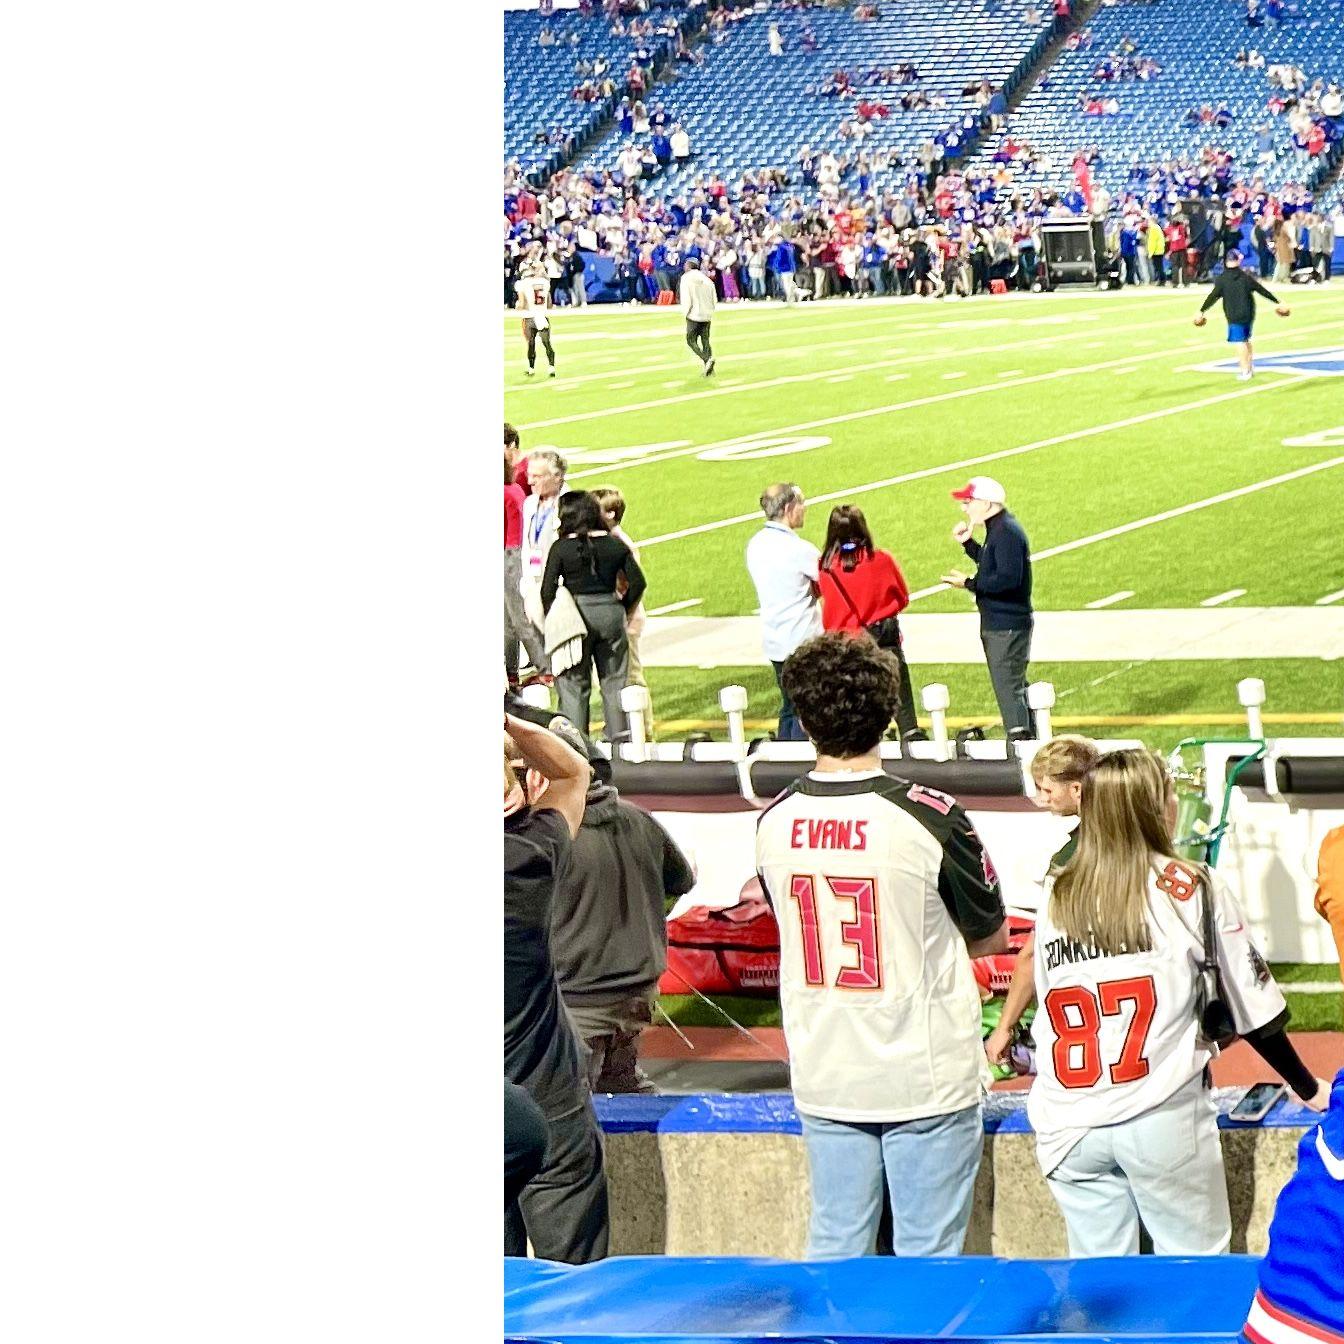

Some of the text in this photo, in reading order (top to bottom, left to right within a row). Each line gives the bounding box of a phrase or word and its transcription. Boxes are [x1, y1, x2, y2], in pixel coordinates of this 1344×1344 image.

[791, 819, 869, 850] EVANS
[790, 873, 883, 990] 13
[1044, 975, 1158, 1089] 87
